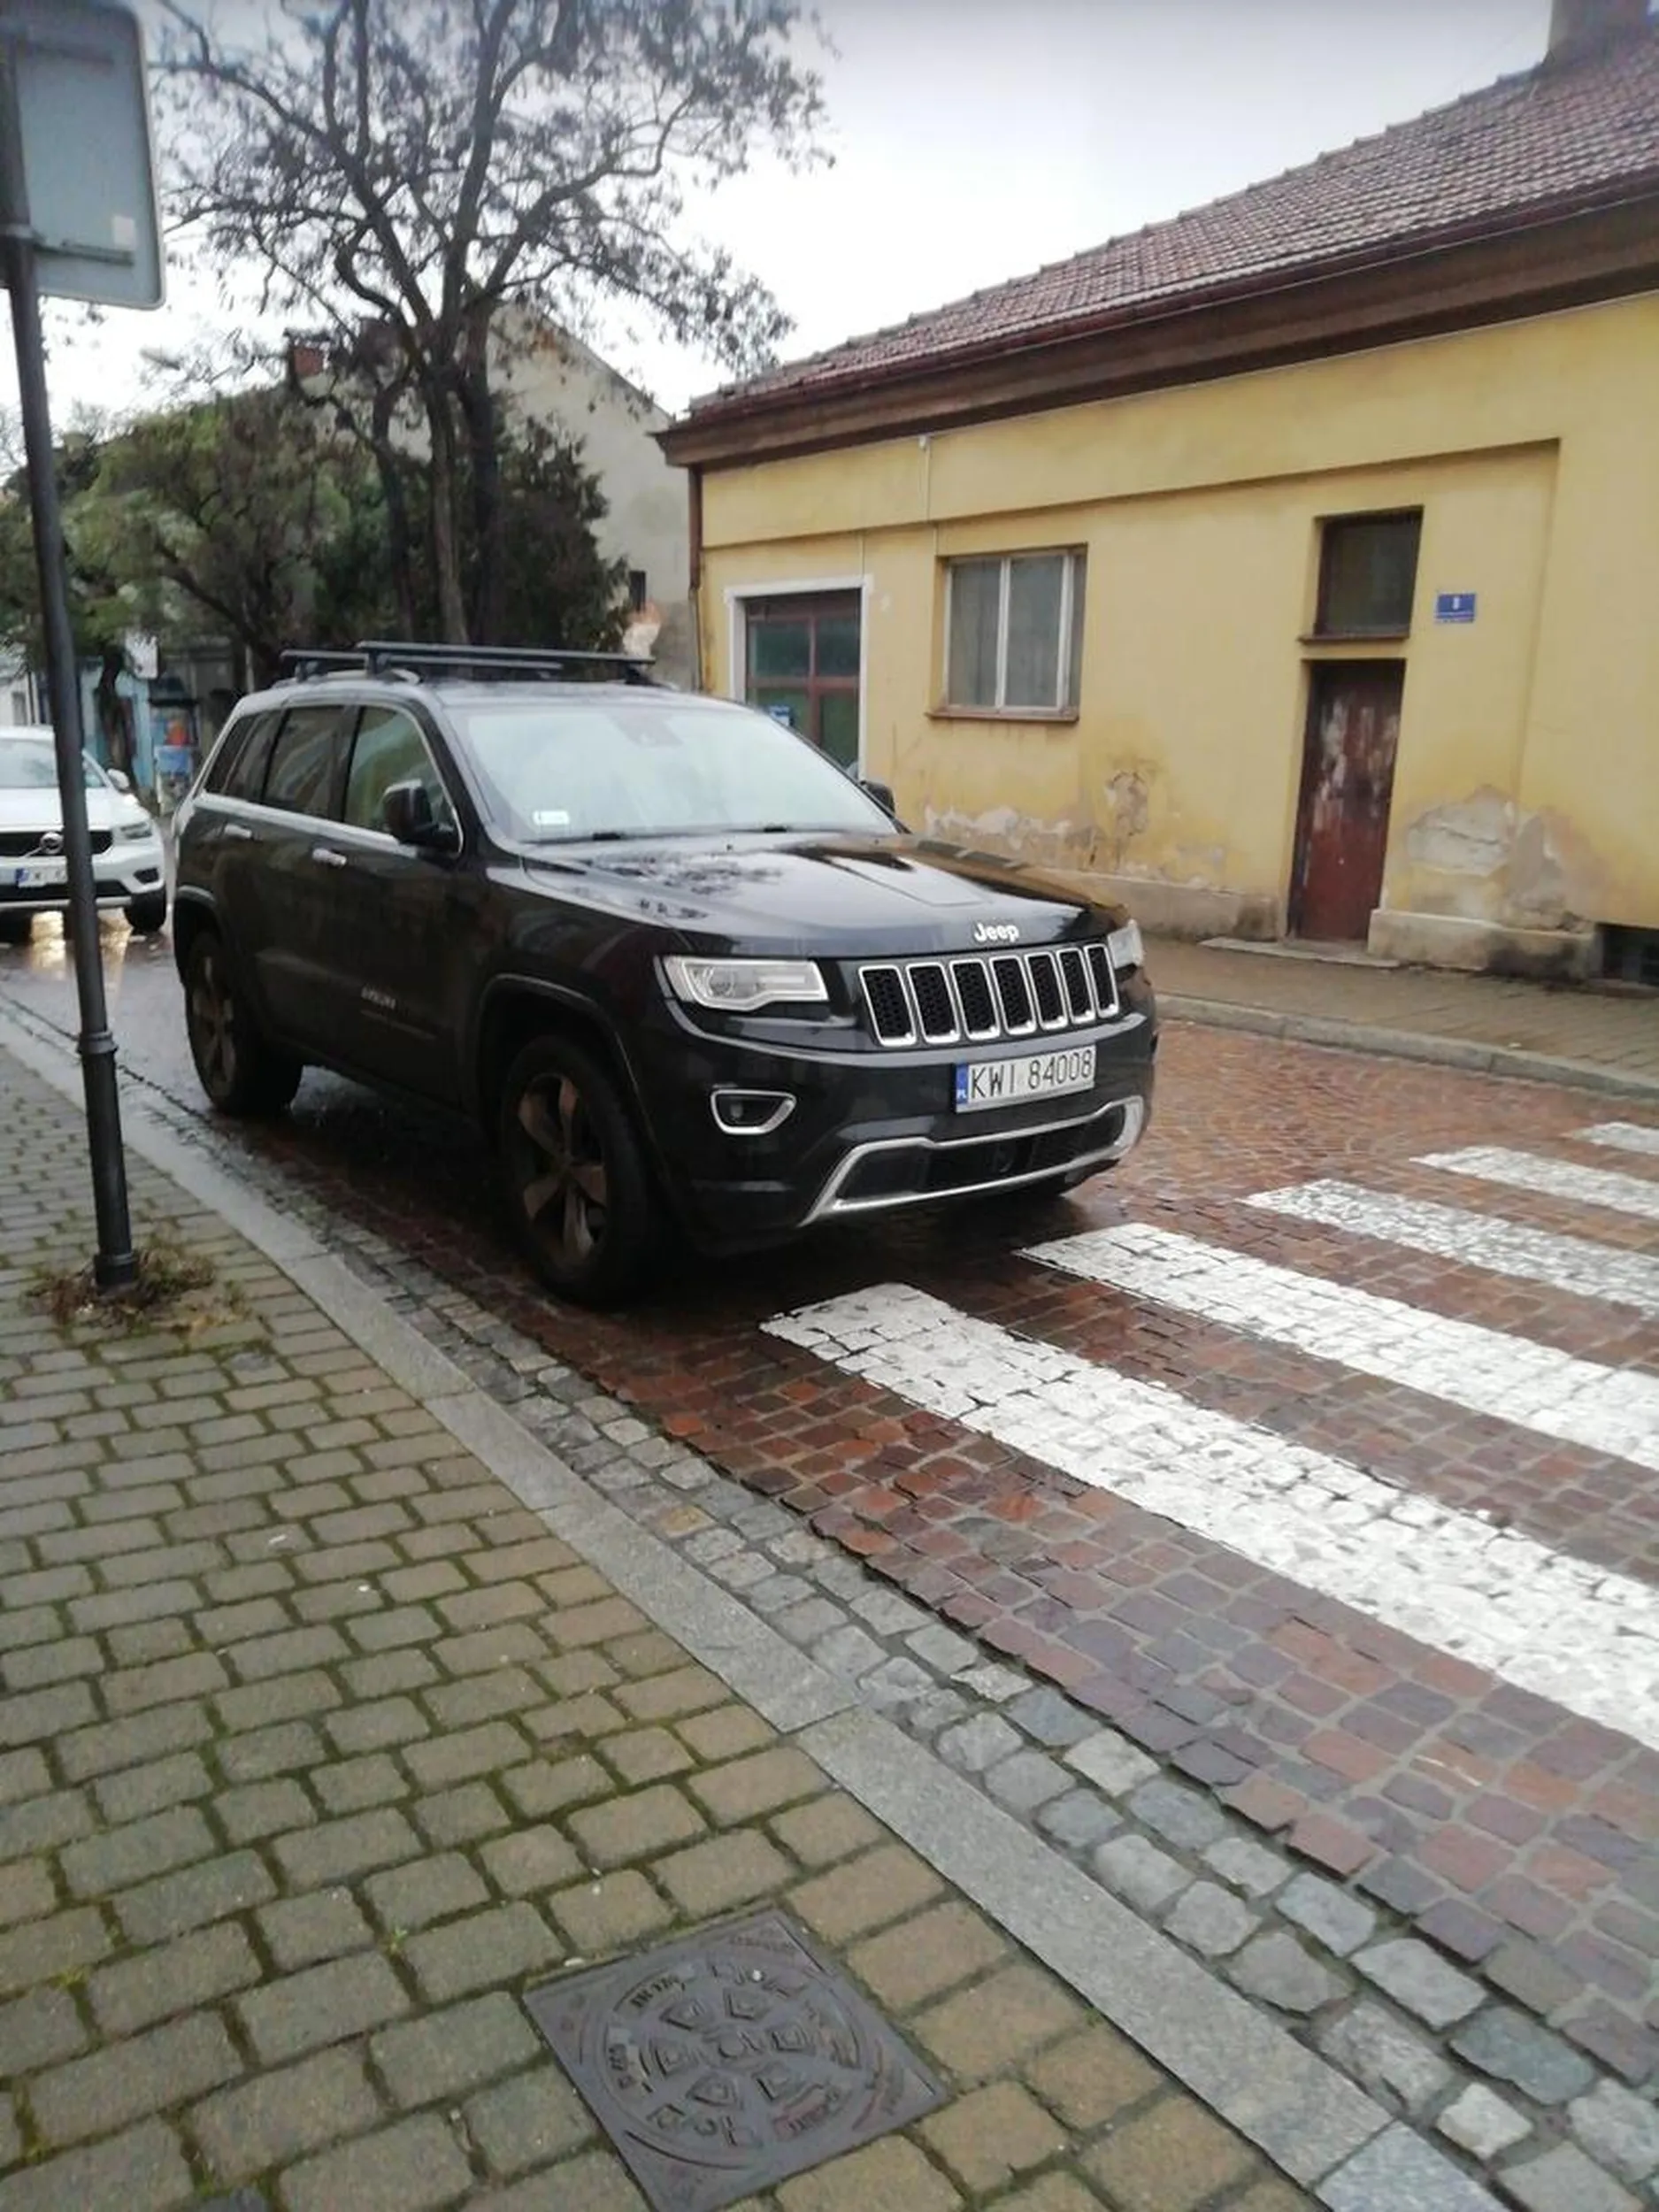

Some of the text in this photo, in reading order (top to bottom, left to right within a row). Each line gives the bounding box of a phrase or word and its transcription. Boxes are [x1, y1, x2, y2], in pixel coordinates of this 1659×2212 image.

[974, 922, 1019, 942] Jeep
[972, 1049, 1092, 1098] KWI 84008
